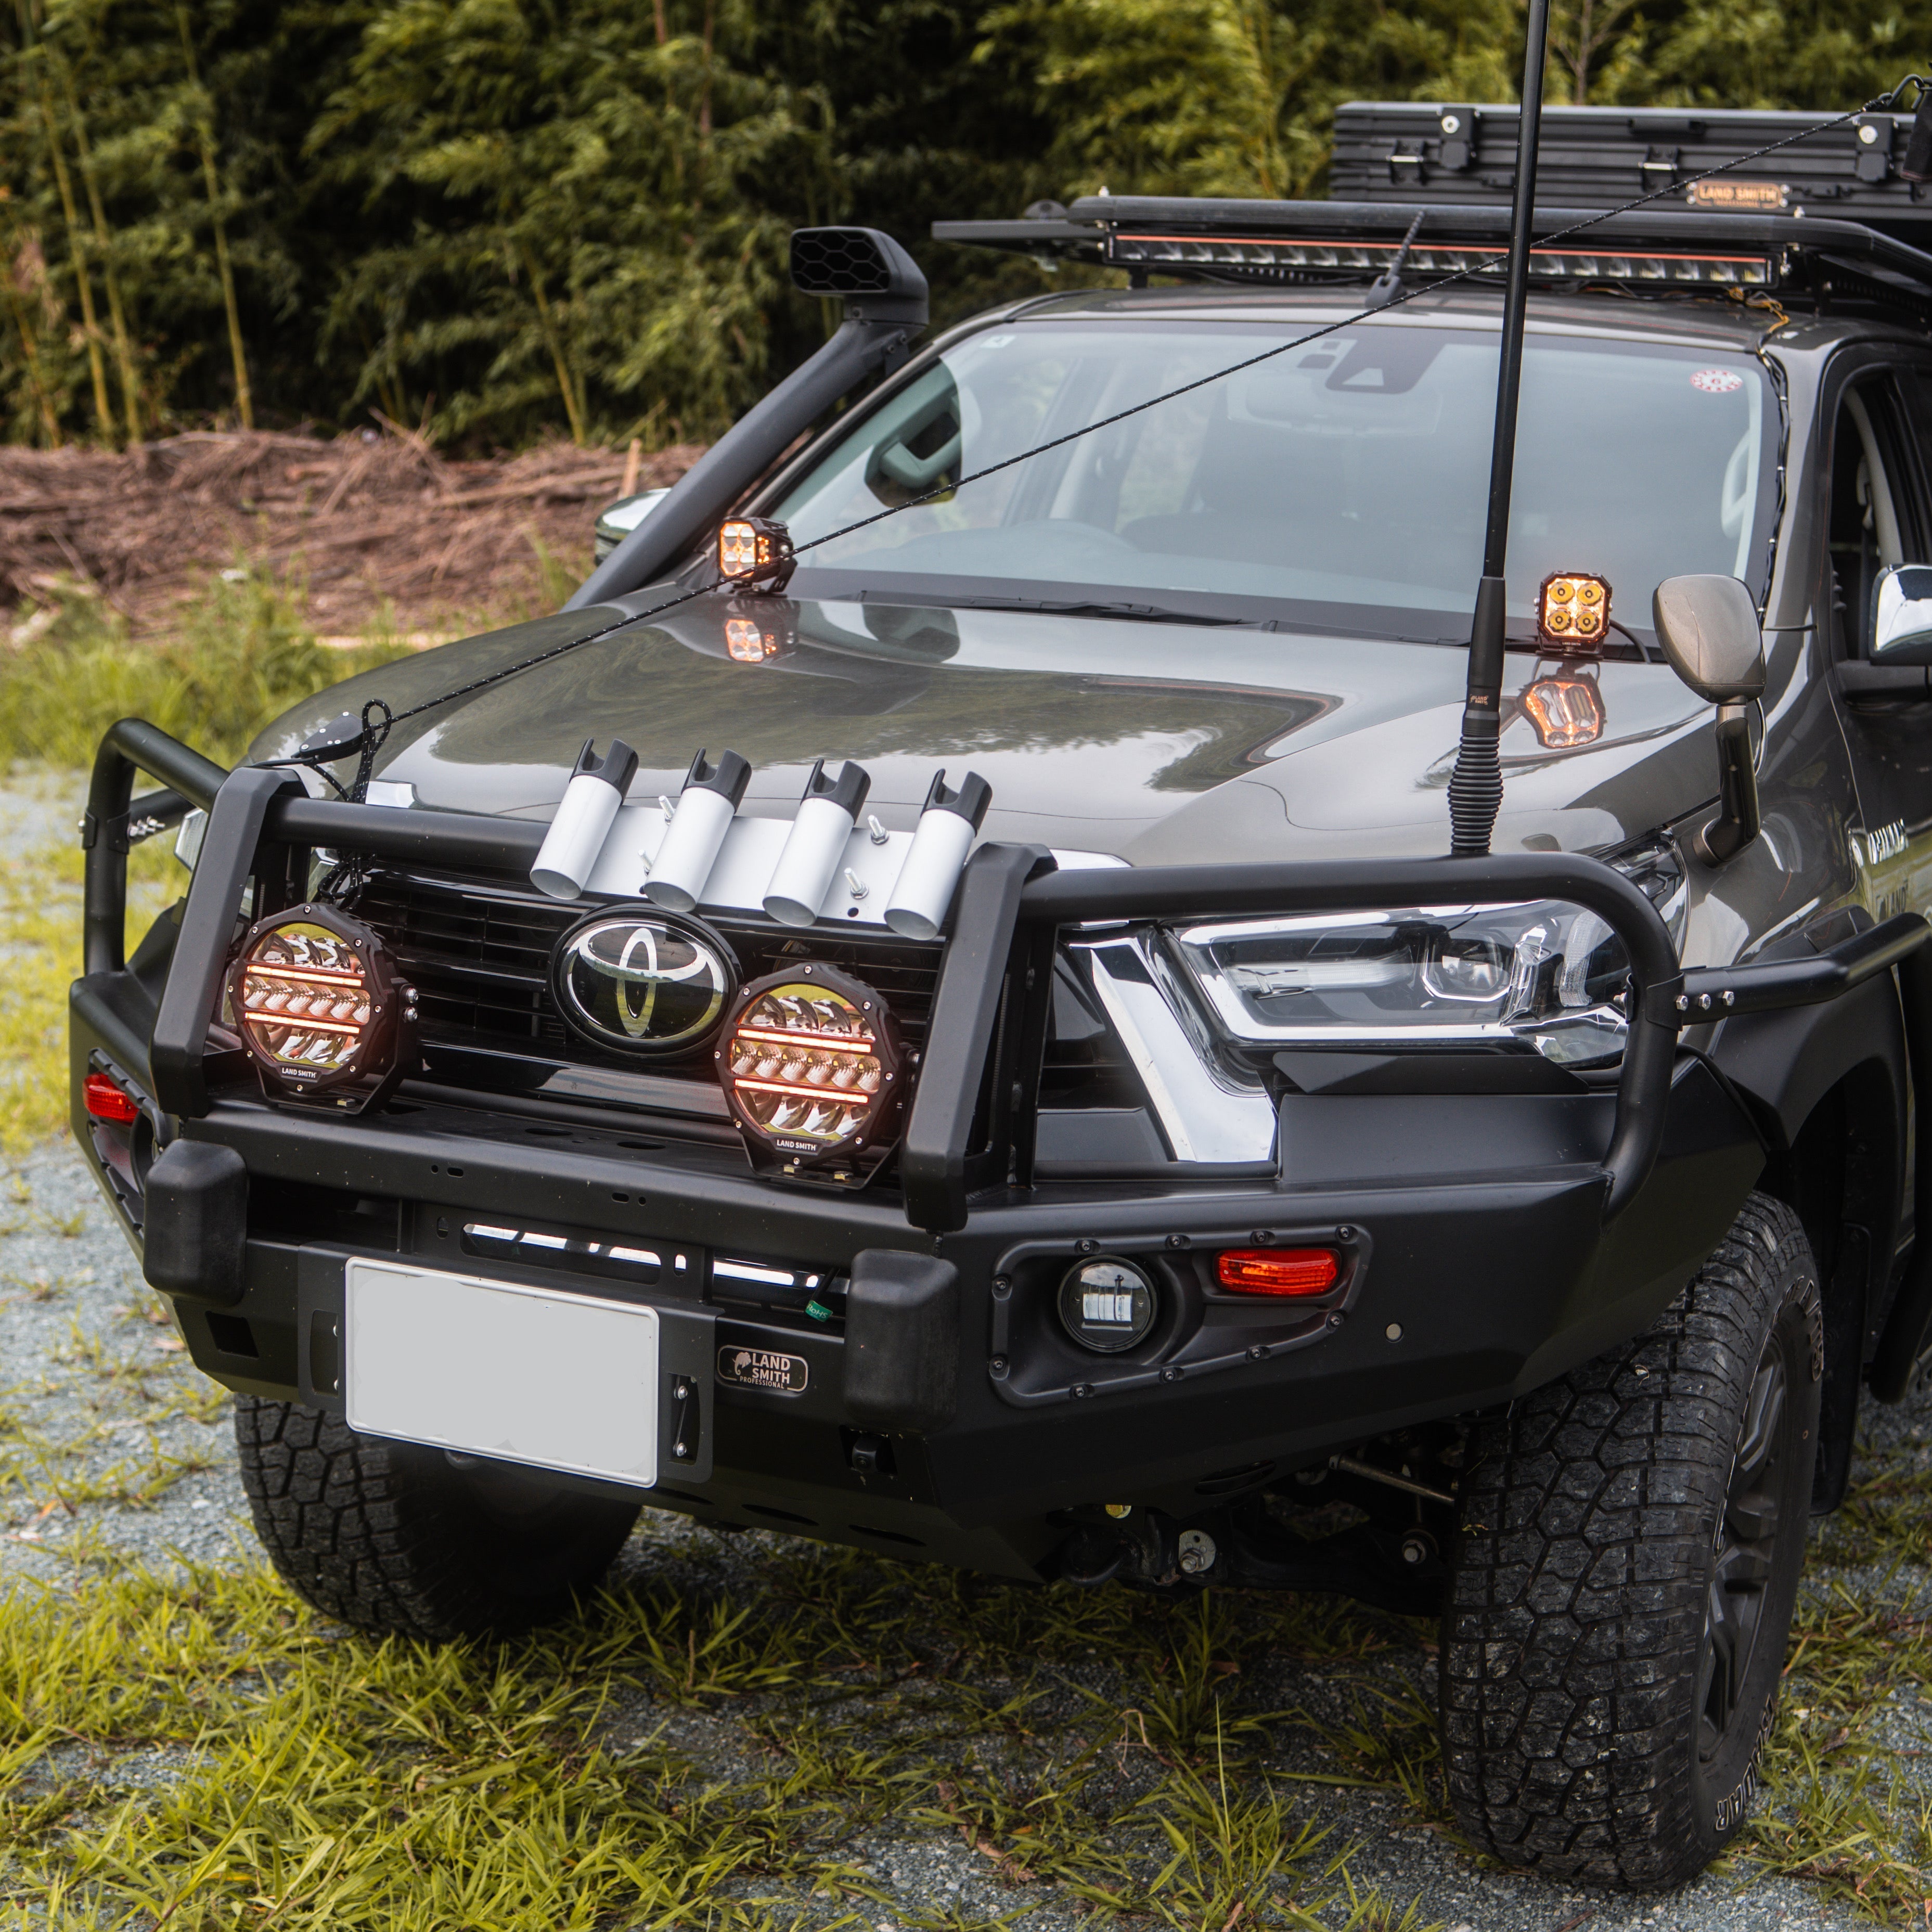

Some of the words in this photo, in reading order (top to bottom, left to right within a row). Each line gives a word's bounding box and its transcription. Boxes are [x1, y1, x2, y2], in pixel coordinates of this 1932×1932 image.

[1699, 186, 1734, 200] LAND
[1735, 187, 1777, 201] SMITH
[298, 1070, 316, 1078] SMITH
[777, 1139, 794, 1148] LAND
[795, 1142, 816, 1151] SMITH
[807, 1304, 828, 1319] RoHS
[752, 1353, 790, 1371] LAND
[740, 1376, 784, 1389] PROFESSIONAL
[752, 1368, 790, 1384] SMITH
